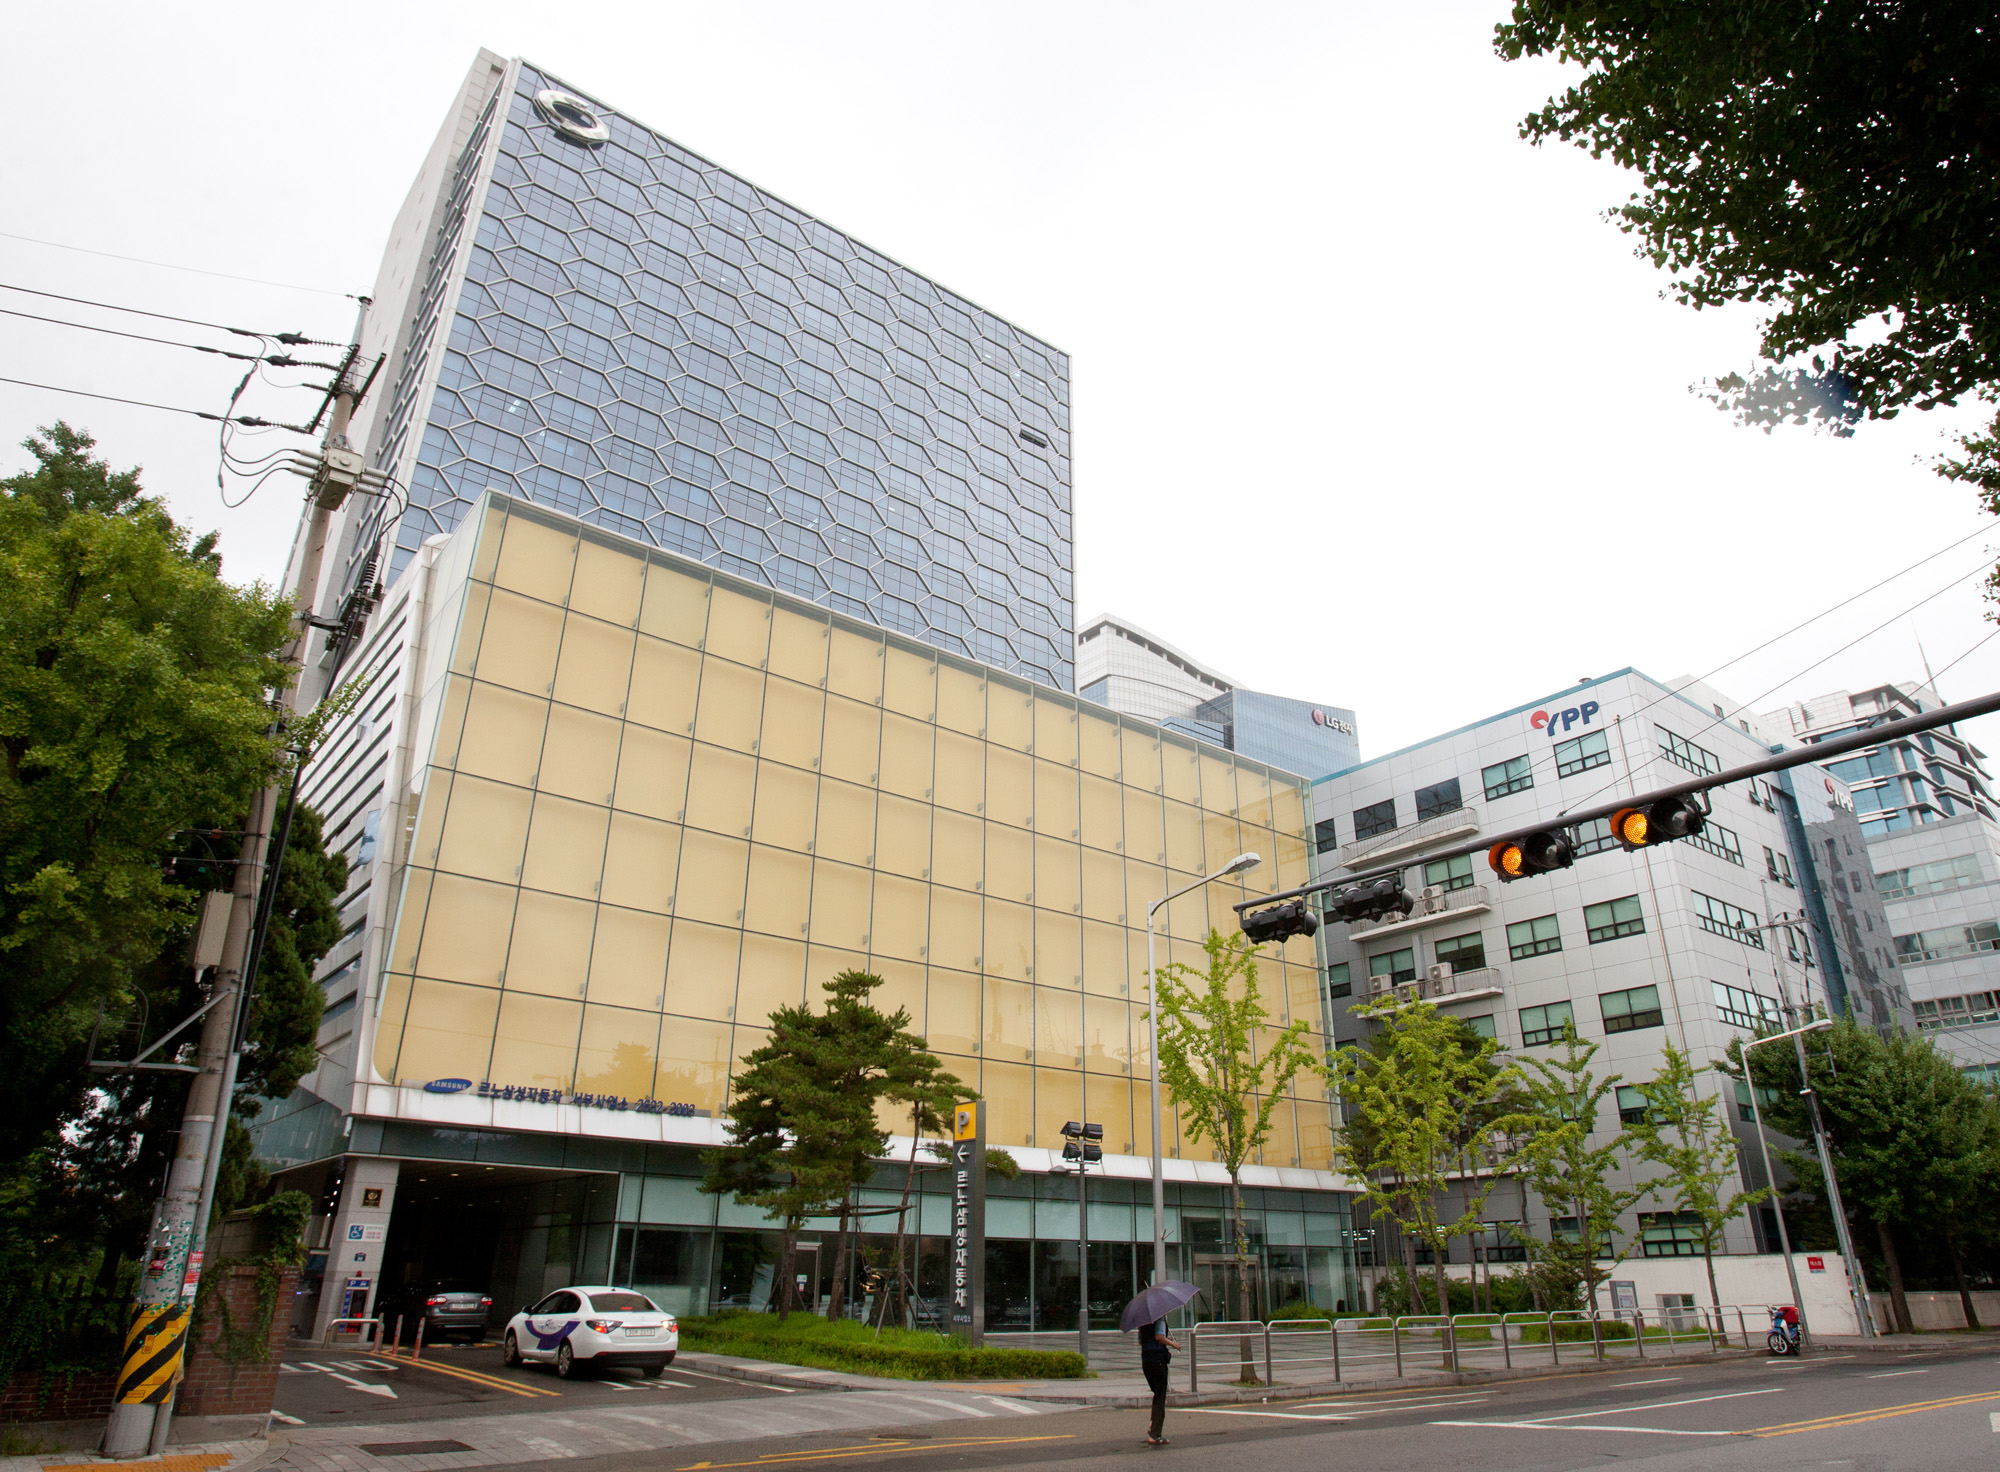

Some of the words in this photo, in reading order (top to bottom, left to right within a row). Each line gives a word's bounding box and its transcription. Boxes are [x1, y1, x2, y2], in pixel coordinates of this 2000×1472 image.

[1547, 701, 1599, 737] YPP
[1833, 789, 1854, 813] YPP
[431, 1081, 467, 1090] SAMSUNG
[477, 1081, 563, 1104] 르노삼성자동차
[571, 1091, 628, 1111] 서부사업소
[957, 1111, 970, 1134] P
[955, 1170, 969, 1308] 르노삼성자동차
